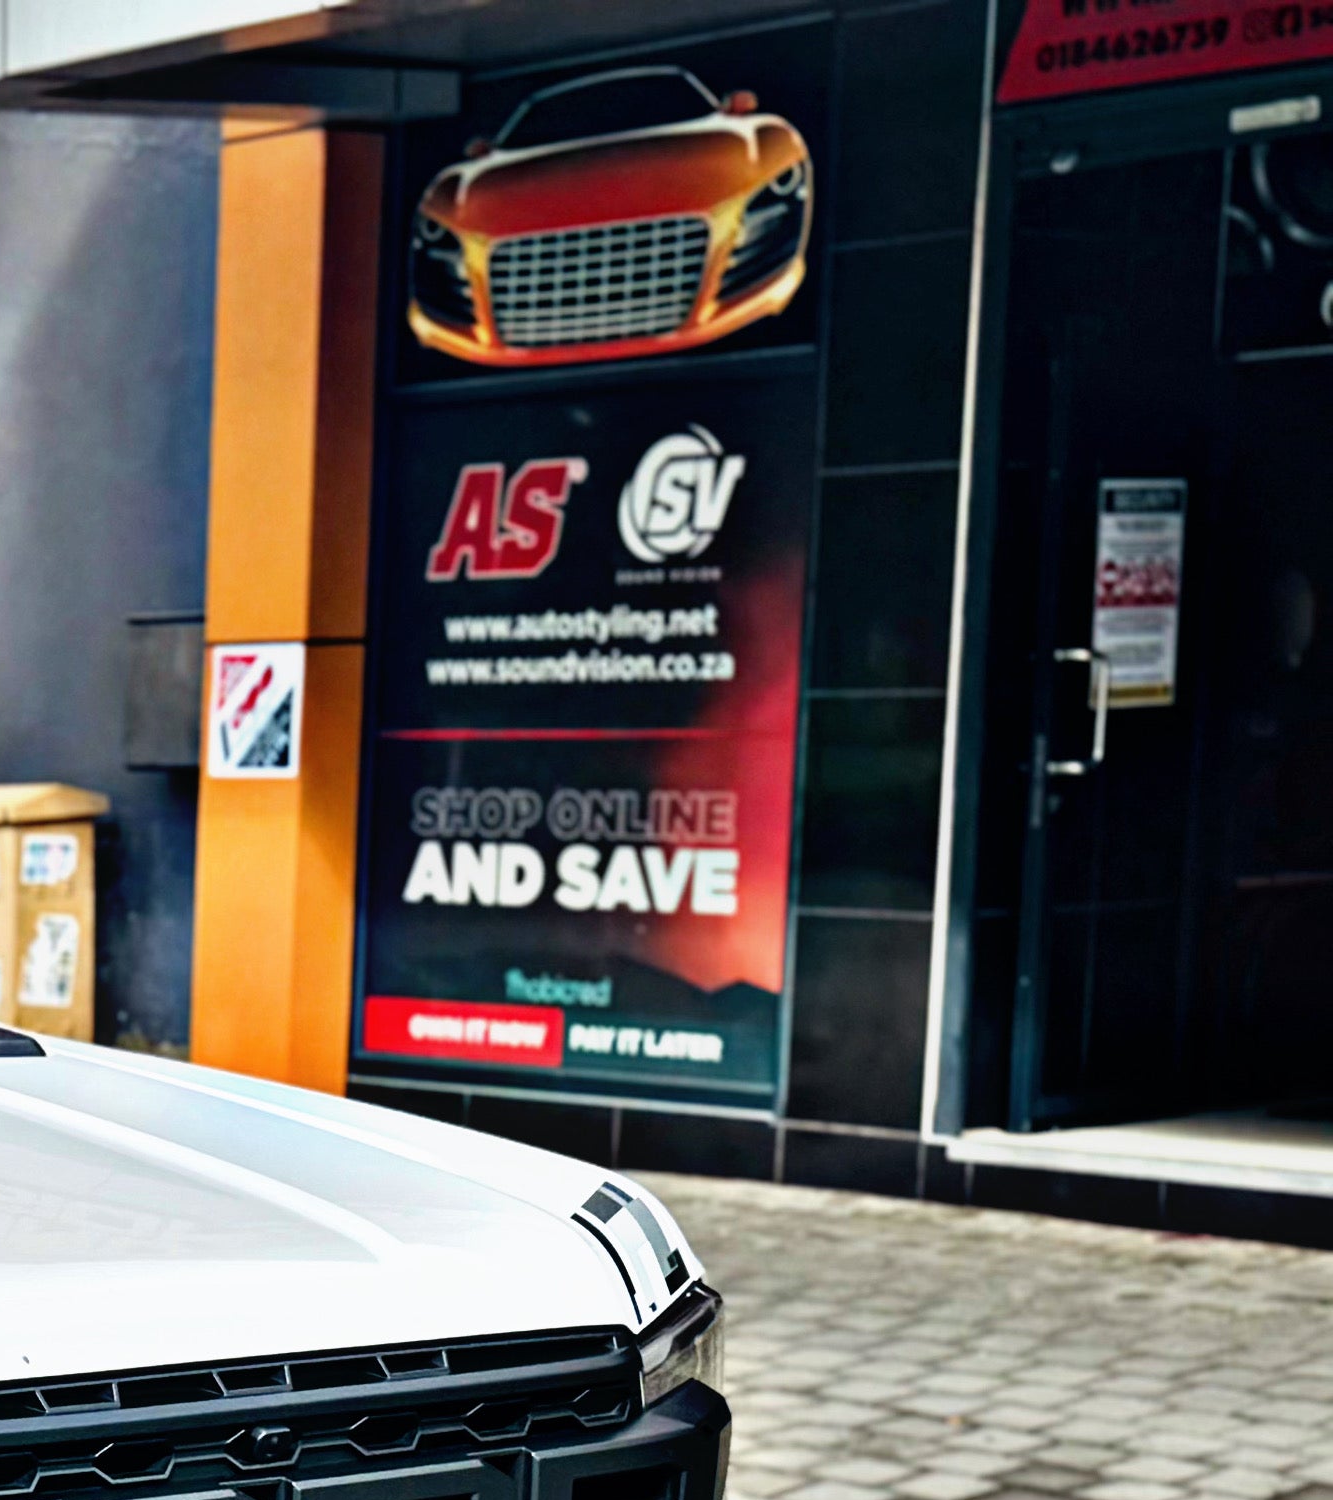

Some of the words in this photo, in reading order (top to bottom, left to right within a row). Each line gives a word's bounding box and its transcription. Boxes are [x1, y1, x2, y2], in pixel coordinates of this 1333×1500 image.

[426, 457, 573, 582] AS
[445, 605, 717, 643] www.autostyling.net
[426, 649, 735, 684] www.soundvision.co.za
[410, 786, 542, 839] SHOP
[546, 788, 736, 843] ONLINE
[403, 841, 545, 906] AND
[554, 843, 739, 915] SAVE
[569, 1023, 615, 1052] PAY
[617, 1027, 643, 1055] IT
[643, 1029, 723, 1062] LATER
